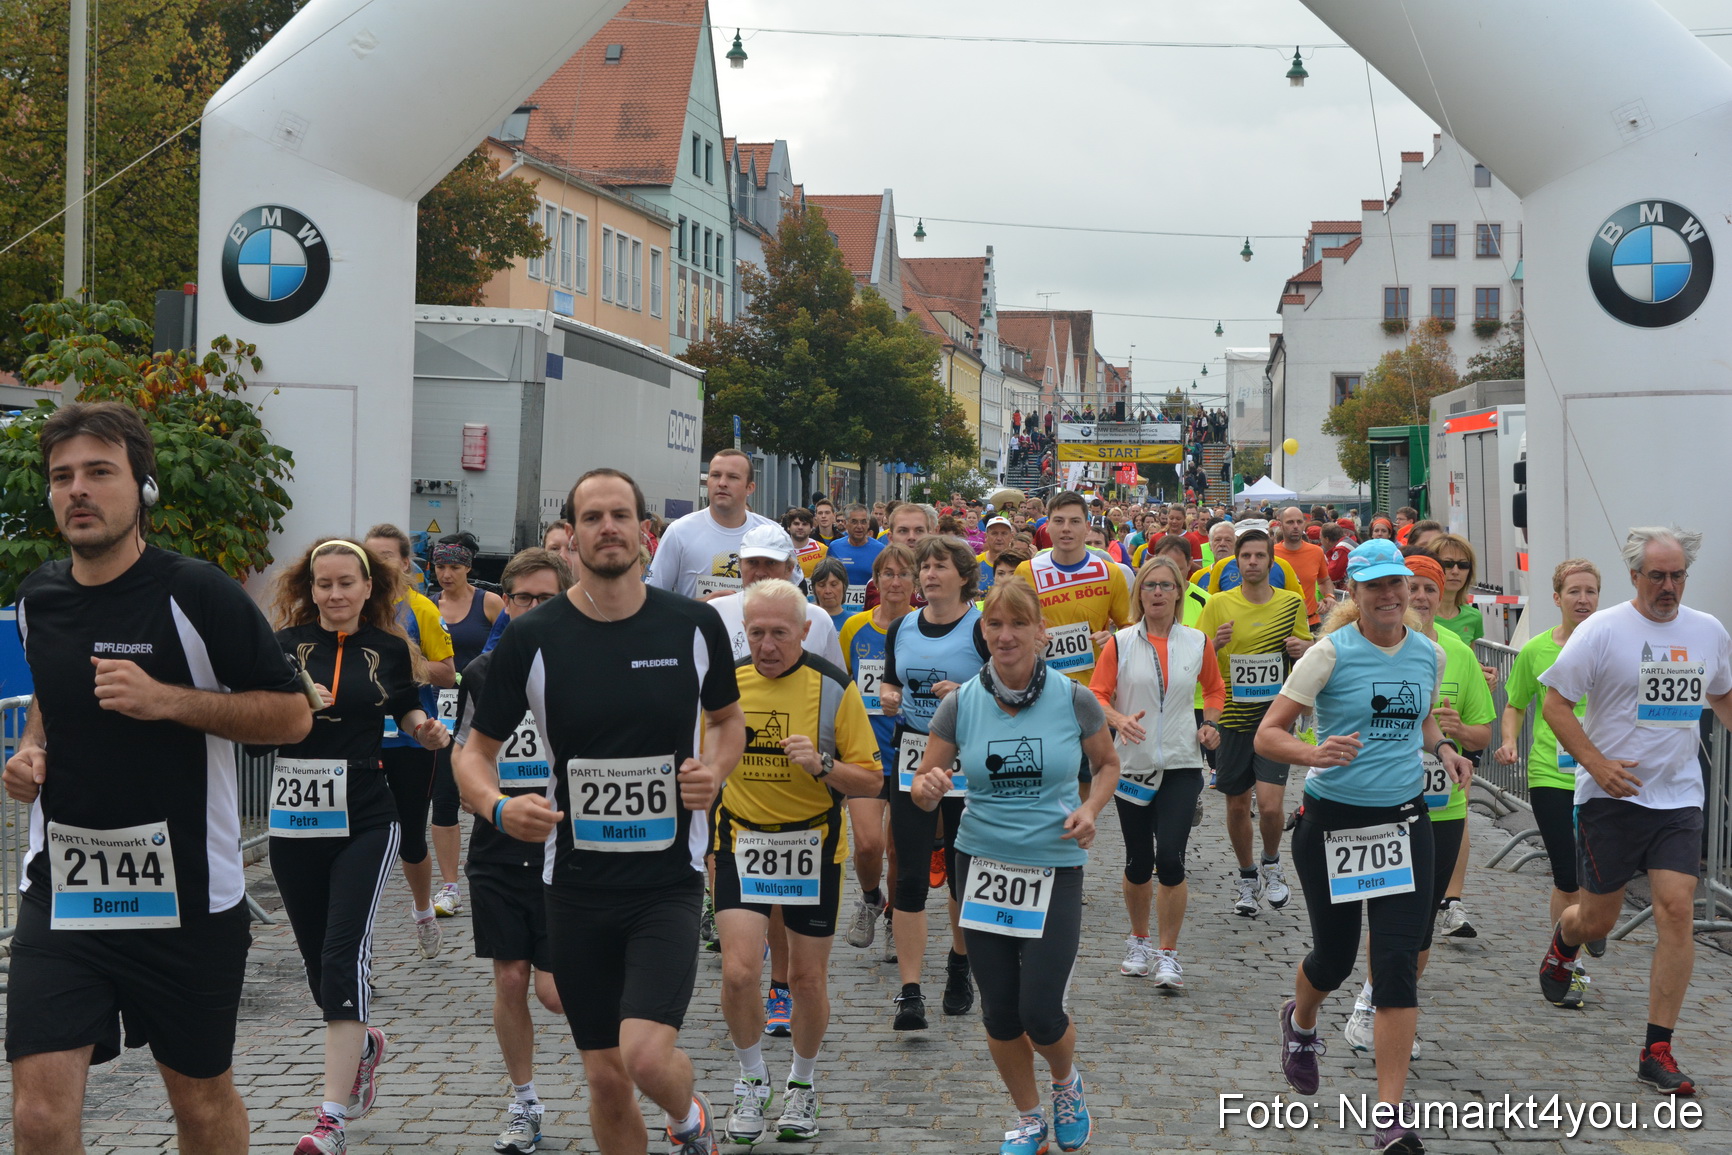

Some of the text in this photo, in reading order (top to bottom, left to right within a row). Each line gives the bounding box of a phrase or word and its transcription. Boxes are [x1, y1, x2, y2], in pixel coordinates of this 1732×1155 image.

[229, 208, 322, 248] BMW
[1599, 203, 1705, 246] BMW
[667, 410, 697, 453] BOCK
[1098, 448, 1141, 458] START
[802, 553, 822, 562] BÖGL
[846, 592, 865, 604] 745
[1040, 586, 1110, 608] MAX BÖGL
[1056, 628, 1080, 636] Neumarkt
[103, 643, 153, 654] PFLEIDERER
[1046, 634, 1088, 658] 2460
[639, 659, 678, 668] PFLEIDERER
[1052, 656, 1084, 670] Christoph
[1236, 665, 1278, 684] 2579
[1646, 678, 1702, 702] 3329
[872, 698, 880, 708] Co
[1648, 706, 1694, 717] MATTHIAS
[1370, 718, 1416, 730] HIRSCH
[505, 730, 537, 758] 23
[902, 738, 922, 747] PARTL
[743, 756, 789, 767] HIRSCH
[275, 765, 291, 774] PARTL
[518, 764, 549, 778] Rüdig
[570, 767, 656, 777] PARTL Neumarkt
[992, 779, 1042, 788] HIRSCH
[1424, 770, 1446, 792] 03
[276, 778, 334, 807] 2341
[1120, 782, 1138, 796] Karin
[581, 780, 666, 816] 2256
[290, 815, 318, 826] Petra
[602, 826, 646, 838] Martin
[1327, 831, 1394, 843] PARTL Neumarkt
[51, 832, 147, 847] PARTL Neumarkt
[745, 849, 813, 875] 2816
[1336, 840, 1403, 874] 2703
[64, 848, 164, 886] 2144
[972, 859, 1040, 875] PARTL Neumarkt
[755, 882, 802, 896] Wolfgang
[974, 872, 1042, 907] 2301
[1358, 877, 1385, 889] Petra
[93, 897, 139, 913] Bernd
[996, 911, 1013, 924] Pia
